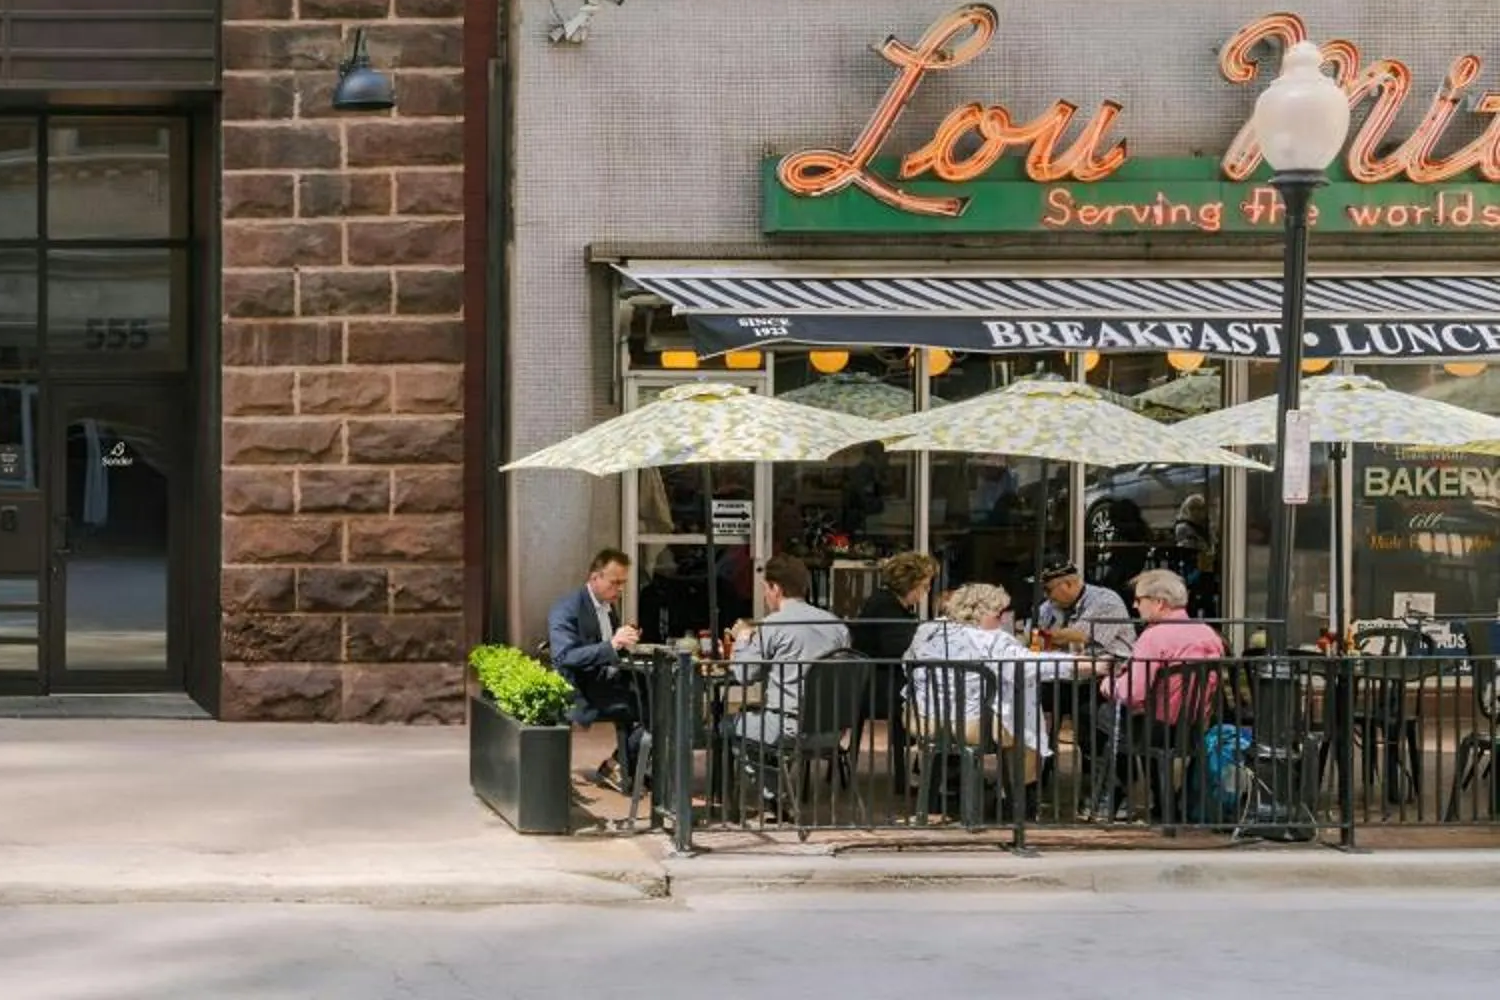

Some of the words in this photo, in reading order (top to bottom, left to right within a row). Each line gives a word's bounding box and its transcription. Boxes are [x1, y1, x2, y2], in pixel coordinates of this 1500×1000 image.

[776, 2, 1128, 217] Lou
[1219, 11, 1500, 184] Mi
[1043, 187, 1223, 232] Serving
[85, 317, 149, 350] 555
[982, 319, 1283, 356] BREAKFAST
[1363, 466, 1500, 497] BAKERY
